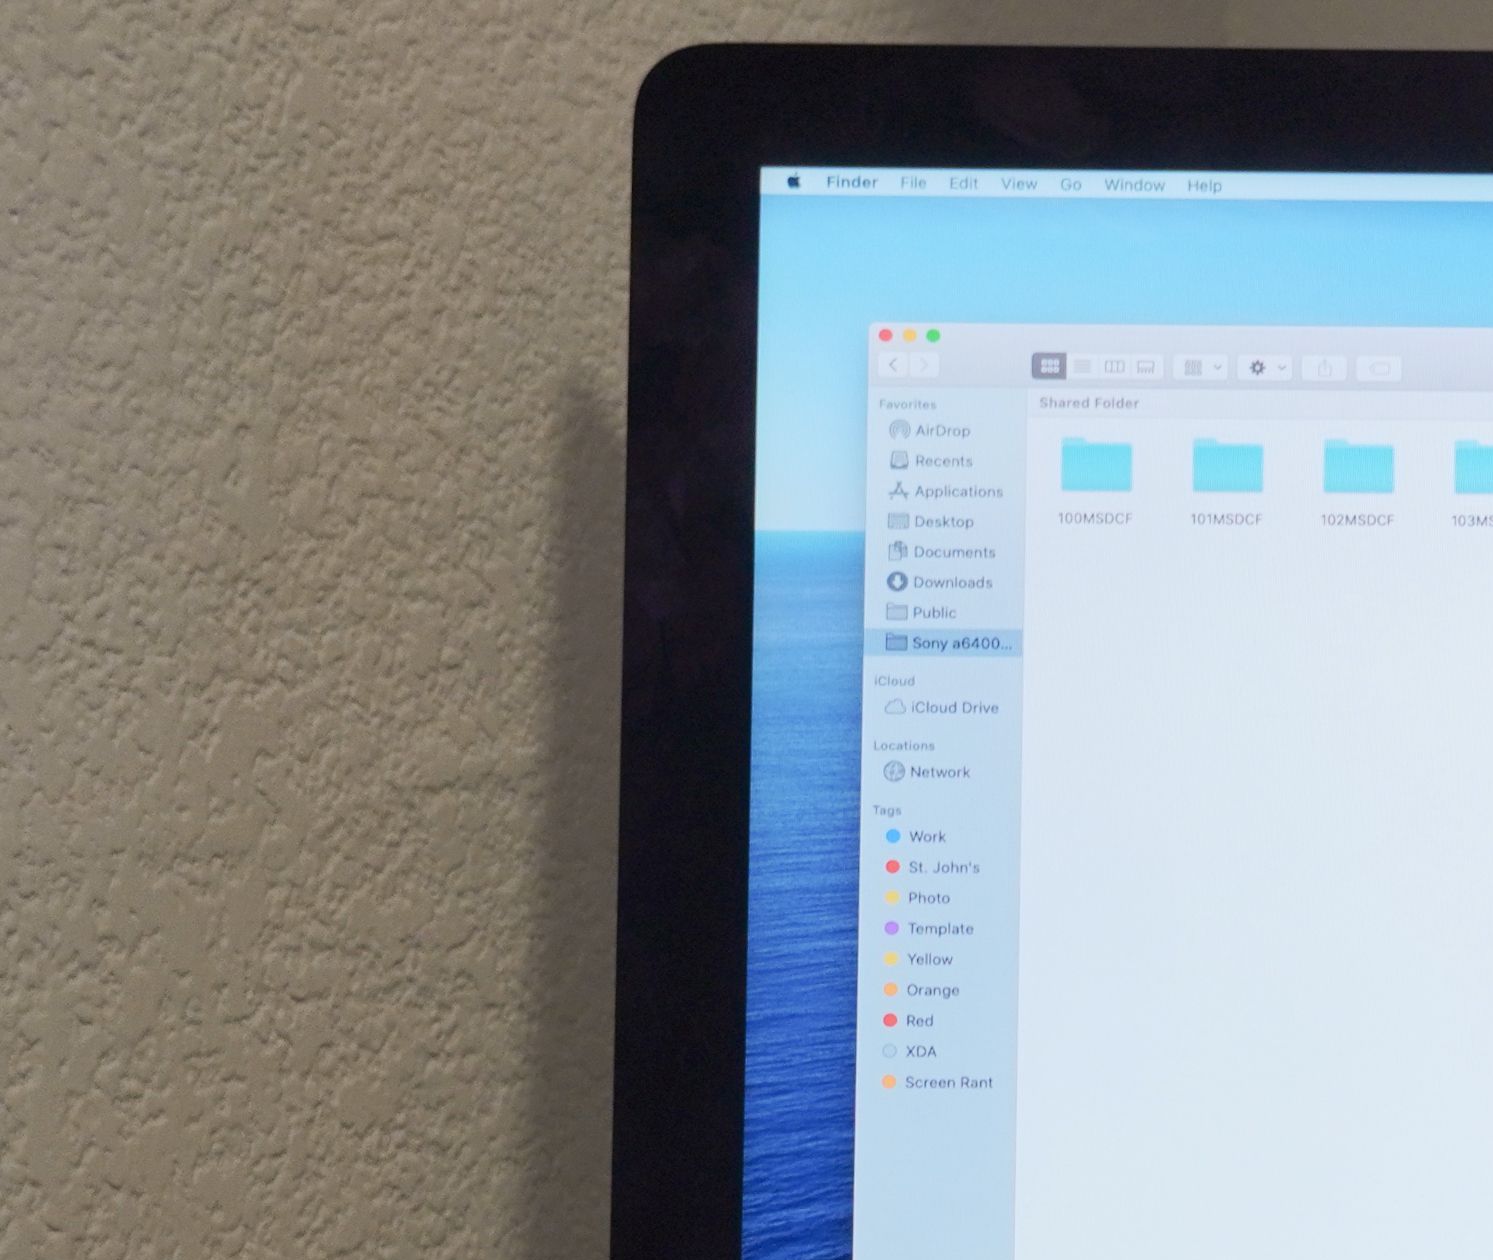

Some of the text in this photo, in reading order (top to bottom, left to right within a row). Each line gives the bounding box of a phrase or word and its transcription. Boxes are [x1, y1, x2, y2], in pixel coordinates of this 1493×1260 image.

[825, 174, 1223, 195] Finder File Edit View Go Window Help
[878, 397, 938, 411] Favorites
[1039, 396, 1140, 411] Shared Folder
[916, 424, 971, 441] AirDrop
[915, 455, 974, 469] Recents
[914, 485, 1004, 501] Applications
[914, 515, 975, 531] Desktop
[1058, 512, 1133, 526] 100MSDCF
[1191, 513, 1263, 527] 101MSDCF
[1320, 514, 1395, 528] 102MSDCF
[914, 545, 997, 560] Documents
[913, 575, 994, 590] Downloads
[913, 606, 957, 620] Public
[912, 636, 949, 652] Sony
[873, 674, 916, 688] iCloud
[911, 701, 1000, 715] iCloud Drive
[873, 739, 935, 753] Locations
[910, 765, 971, 780] Network
[873, 804, 903, 818] Tags
[909, 829, 946, 844] Work
[908, 860, 981, 875] St. John's
[908, 891, 951, 906] Photo
[908, 922, 975, 938] Template
[907, 952, 954, 967] Yellow
[906, 983, 961, 1000] Orange
[906, 1014, 935, 1028] Red
[906, 1045, 938, 1059] XDA
[905, 1075, 994, 1090] Screen Rant
